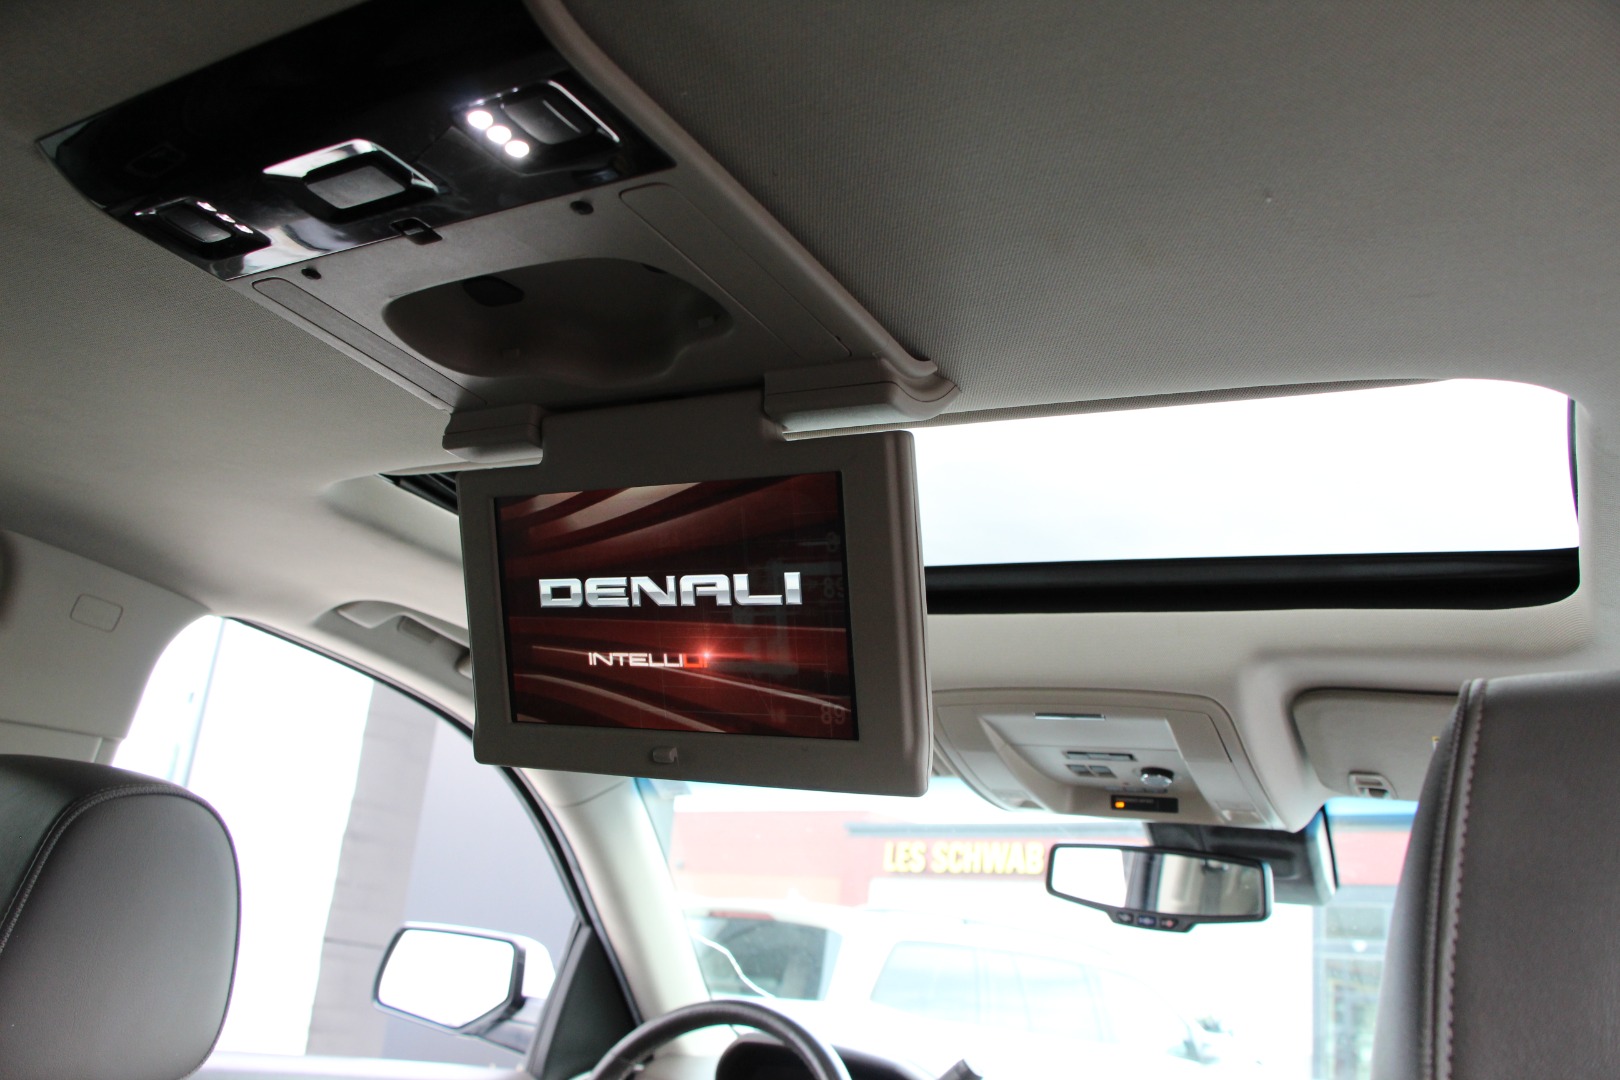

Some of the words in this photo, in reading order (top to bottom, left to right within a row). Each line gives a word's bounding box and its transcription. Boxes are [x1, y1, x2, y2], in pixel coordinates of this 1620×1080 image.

[539, 571, 803, 608] DENALI
[884, 841, 926, 873] LES
[931, 841, 1045, 875] SCHWAB
